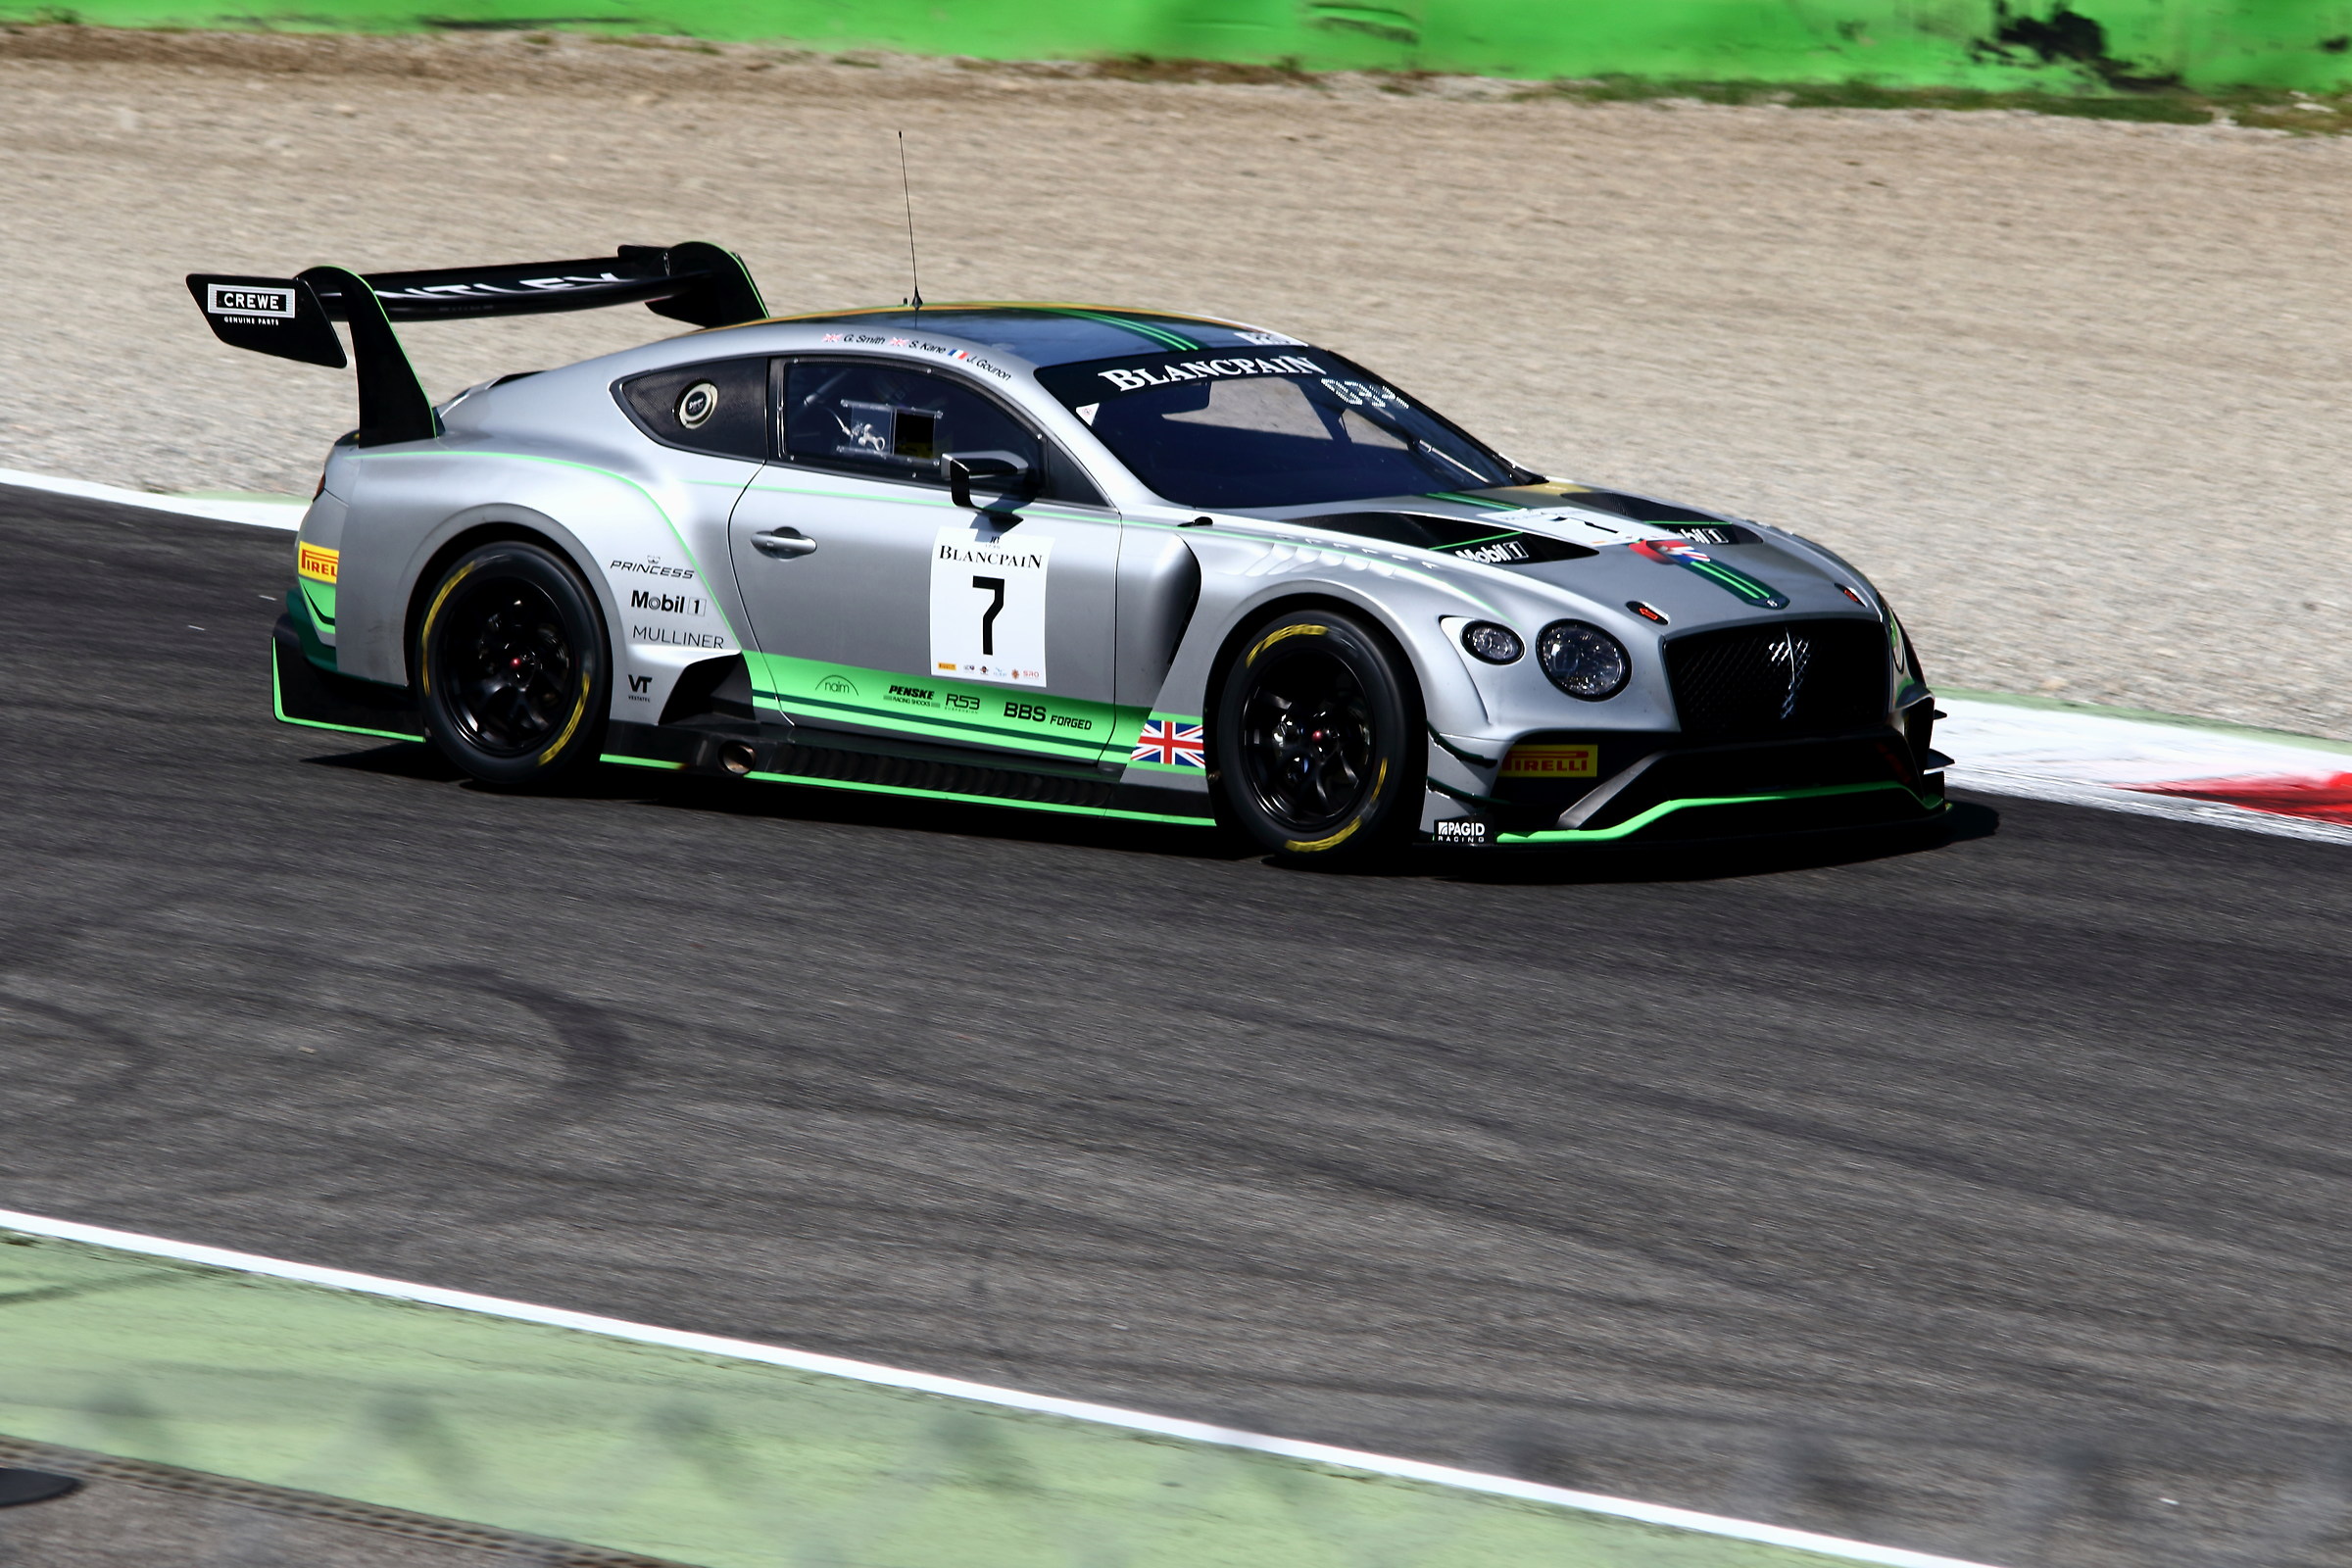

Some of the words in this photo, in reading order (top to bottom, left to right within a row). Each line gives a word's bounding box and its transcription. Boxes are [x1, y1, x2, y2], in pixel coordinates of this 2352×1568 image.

[223, 292, 279, 310] CREWE
[223, 316, 256, 325] GENUINE
[258, 318, 279, 326] PARTS
[843, 334, 855, 343] G.
[857, 334, 886, 345] Smith
[908, 339, 917, 349] S.
[920, 342, 947, 354] Kane
[966, 355, 976, 364] J.
[977, 359, 1011, 381] Gounon
[1098, 354, 1327, 392] BLANCPAIN
[301, 548, 339, 577] PIREL
[939, 544, 1043, 569] BLANCPAIN
[610, 560, 696, 580] PRINCESS
[631, 590, 685, 613] Mobil
[972, 575, 1005, 656] 7
[632, 624, 724, 650] MULLINER
[628, 674, 653, 694] VT
[889, 684, 935, 701] PENSKE
[1003, 702, 1047, 722] BBS
[1050, 714, 1093, 731] FORGED
[1501, 750, 1590, 771] PIRELLI
[1447, 821, 1486, 836] PAGID
